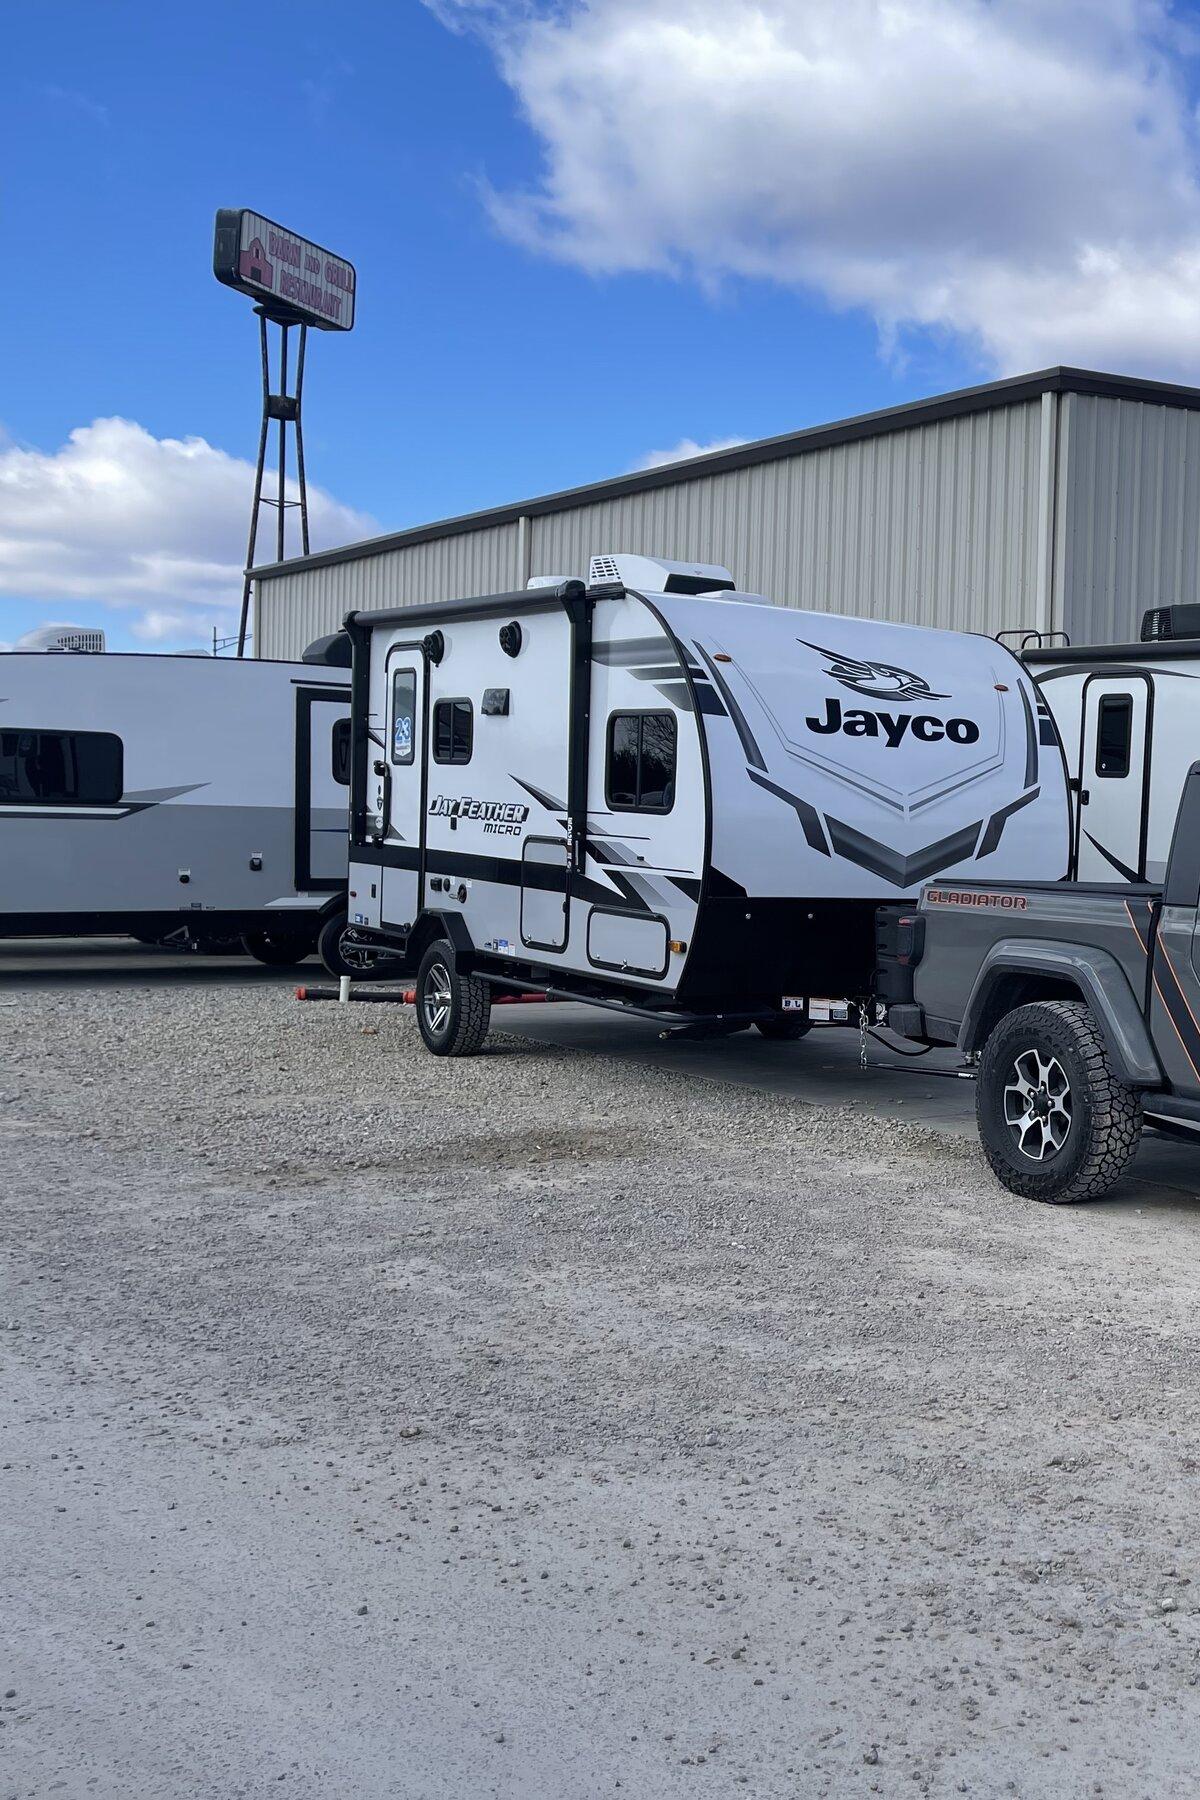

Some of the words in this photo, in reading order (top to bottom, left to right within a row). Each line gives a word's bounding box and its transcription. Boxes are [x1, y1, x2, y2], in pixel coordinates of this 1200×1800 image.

[805, 697, 980, 748] Jayco
[428, 795, 457, 816] JAY
[457, 797, 527, 823] FEATHER
[483, 822, 522, 836] MICRO
[926, 889, 1029, 911] GLADIATOR
